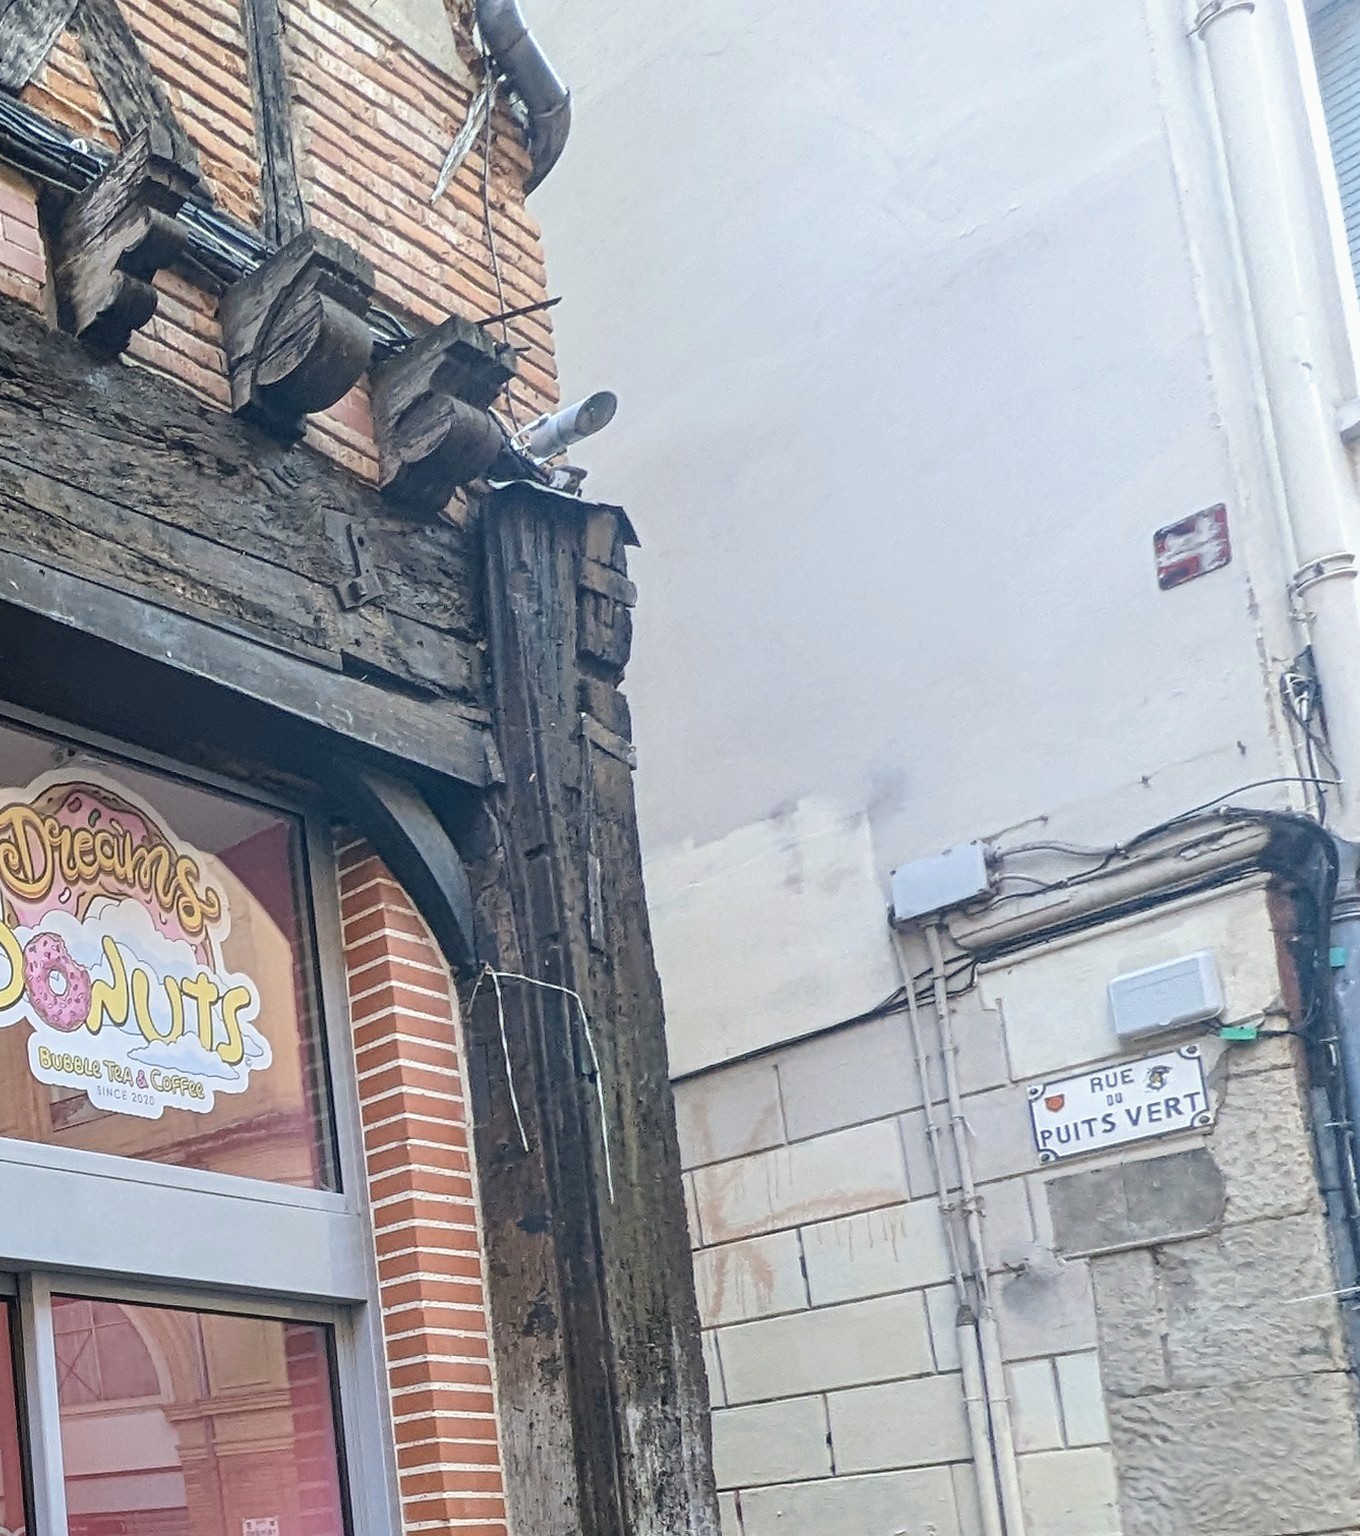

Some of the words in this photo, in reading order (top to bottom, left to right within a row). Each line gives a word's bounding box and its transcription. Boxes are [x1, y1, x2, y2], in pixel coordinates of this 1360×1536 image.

[136, 1069, 149, 1089] &
[1089, 1068, 1135, 1094] RUE
[97, 1085, 127, 1101] SINCE
[131, 1092, 156, 1107] 2020
[1039, 1112, 1117, 1148] PUITS
[1124, 1090, 1202, 1128] VERT
